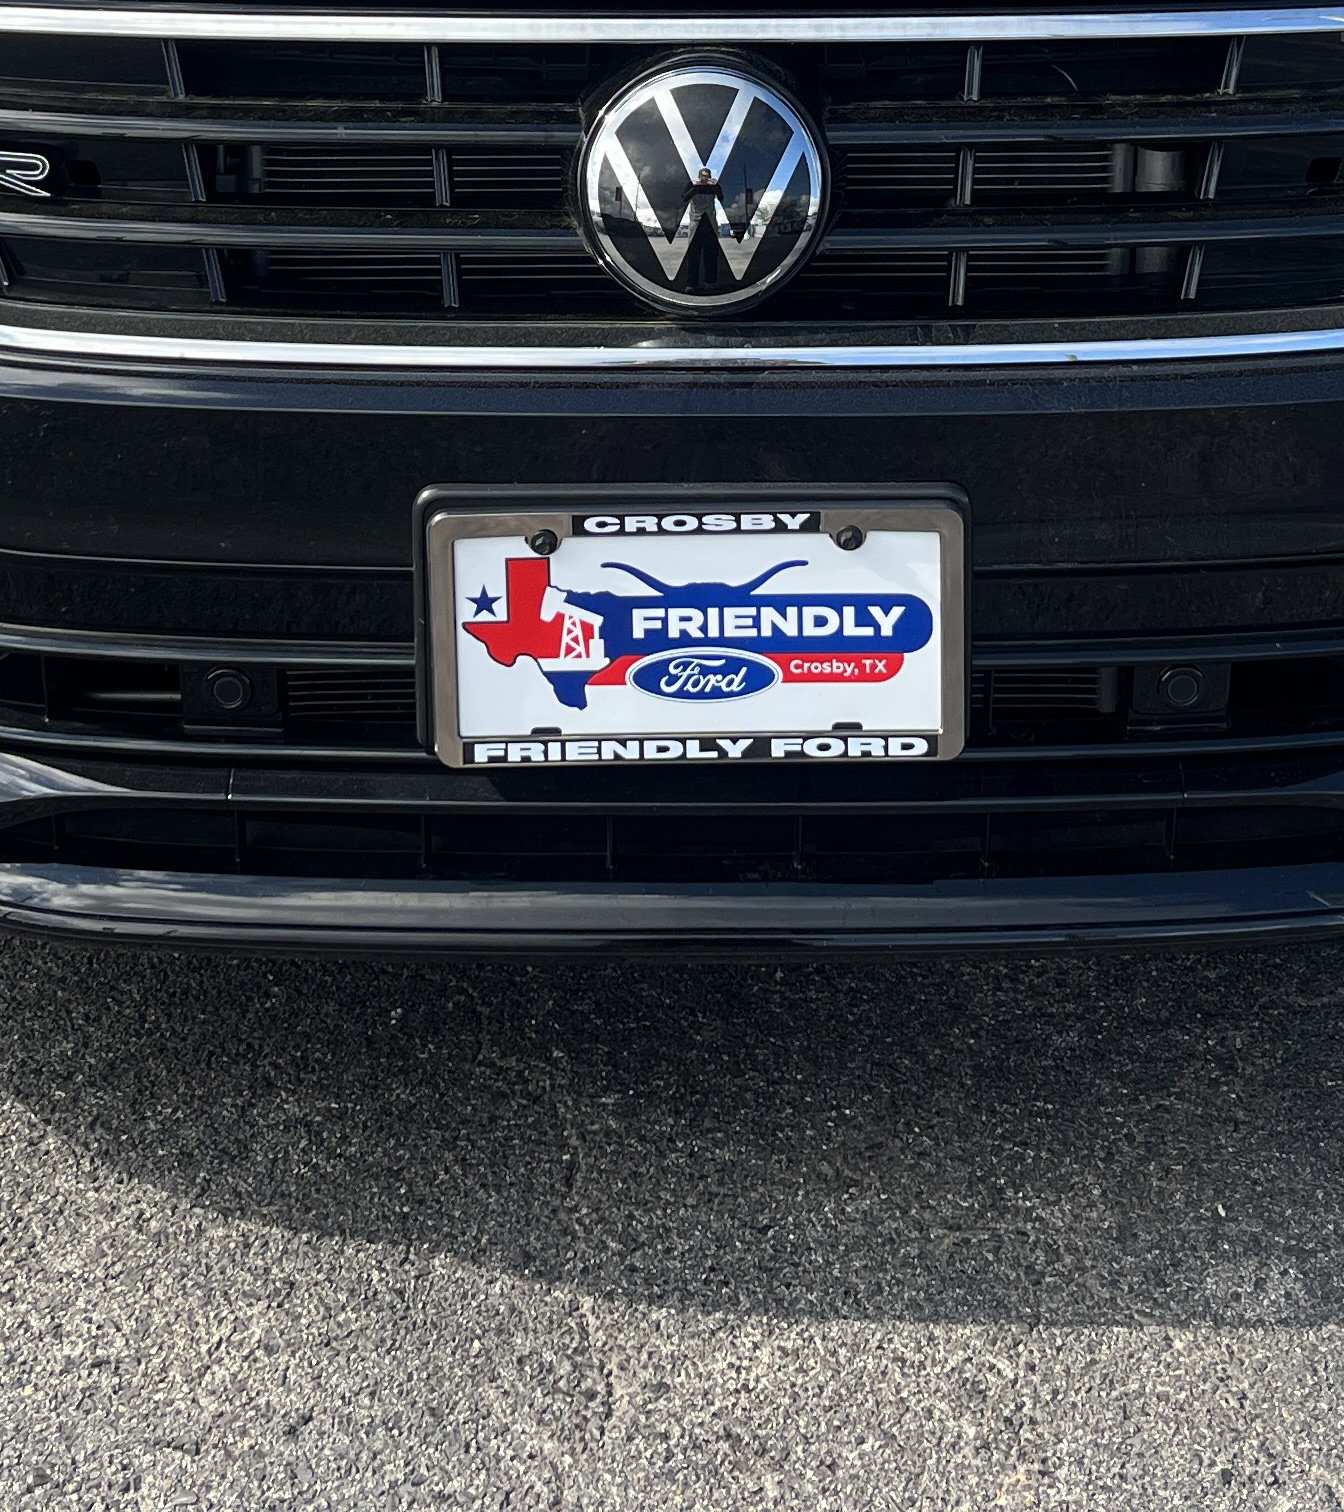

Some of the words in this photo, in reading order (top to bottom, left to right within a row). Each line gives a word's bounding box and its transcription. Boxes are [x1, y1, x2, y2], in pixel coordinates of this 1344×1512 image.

[583, 513, 812, 533] CROSBY
[632, 606, 906, 640] FRIENDLY
[659, 658, 748, 694] Ford
[789, 658, 858, 677] Crosby,
[863, 658, 887, 675] TX
[473, 738, 755, 764] FRIENDLY
[770, 736, 930, 760] FORD
